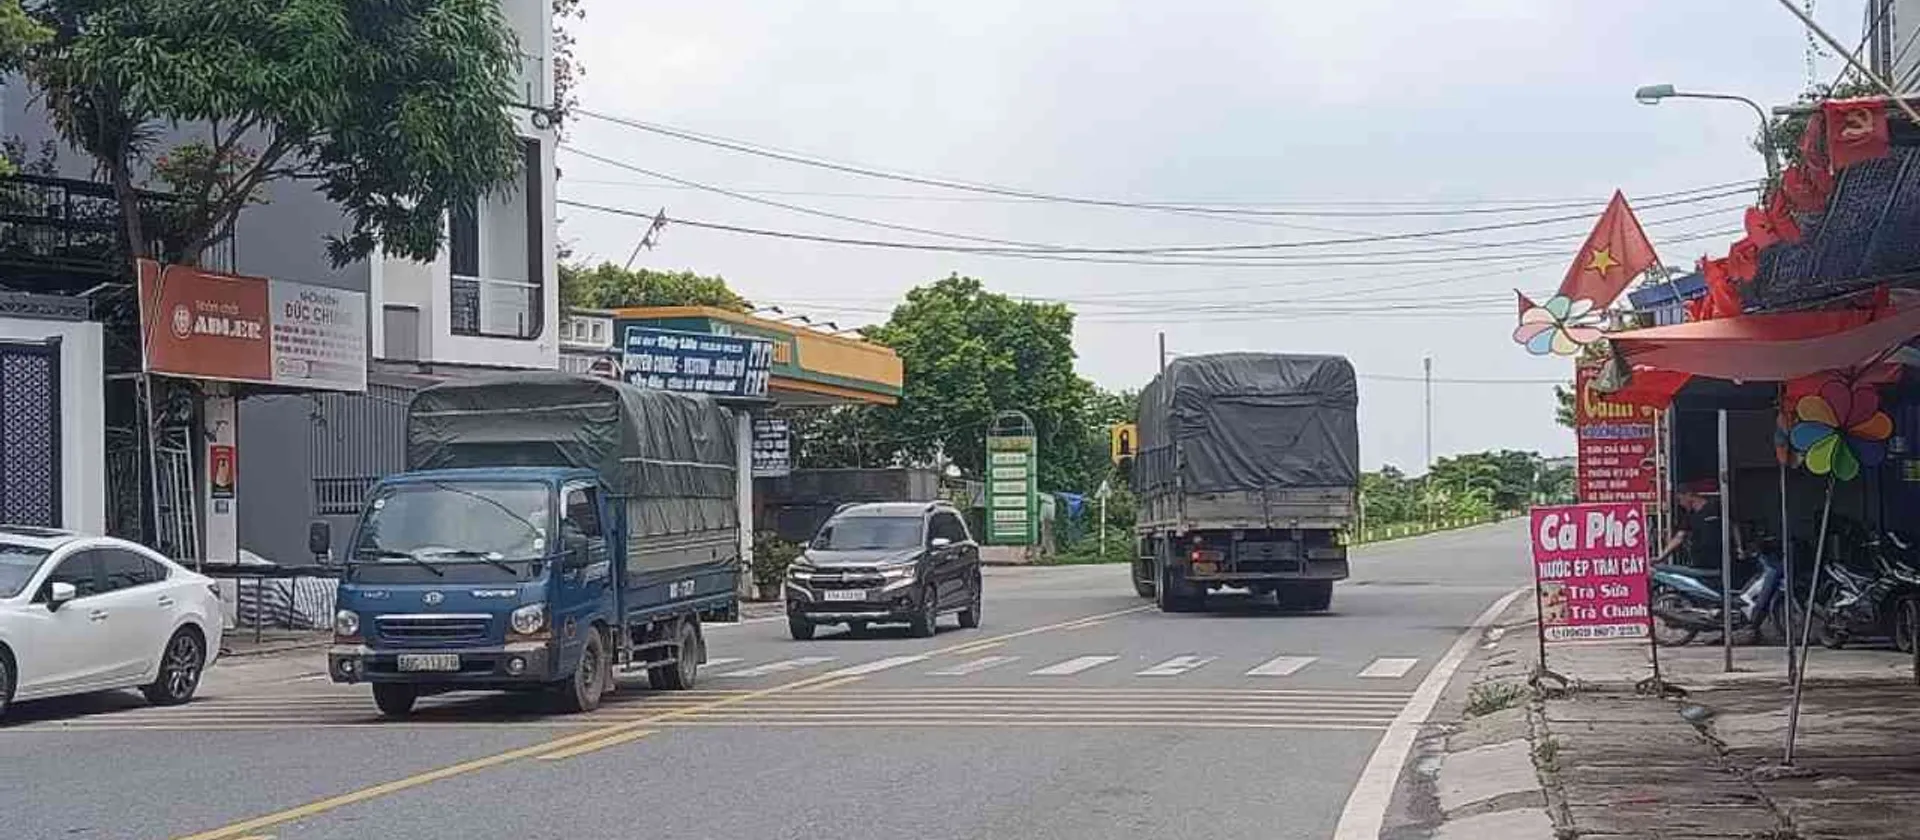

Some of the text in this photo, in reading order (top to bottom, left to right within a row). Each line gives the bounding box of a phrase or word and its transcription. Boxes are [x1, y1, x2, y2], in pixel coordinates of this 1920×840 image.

[194, 315, 263, 339] ADLER
[1540, 508, 1641, 552] Cà Phê
[1539, 558, 1571, 578] NƯỚC
[1573, 558, 1590, 577] ÉP
[1601, 582, 1630, 598] Sữa
[1570, 603, 1648, 619] Trà Chanh
